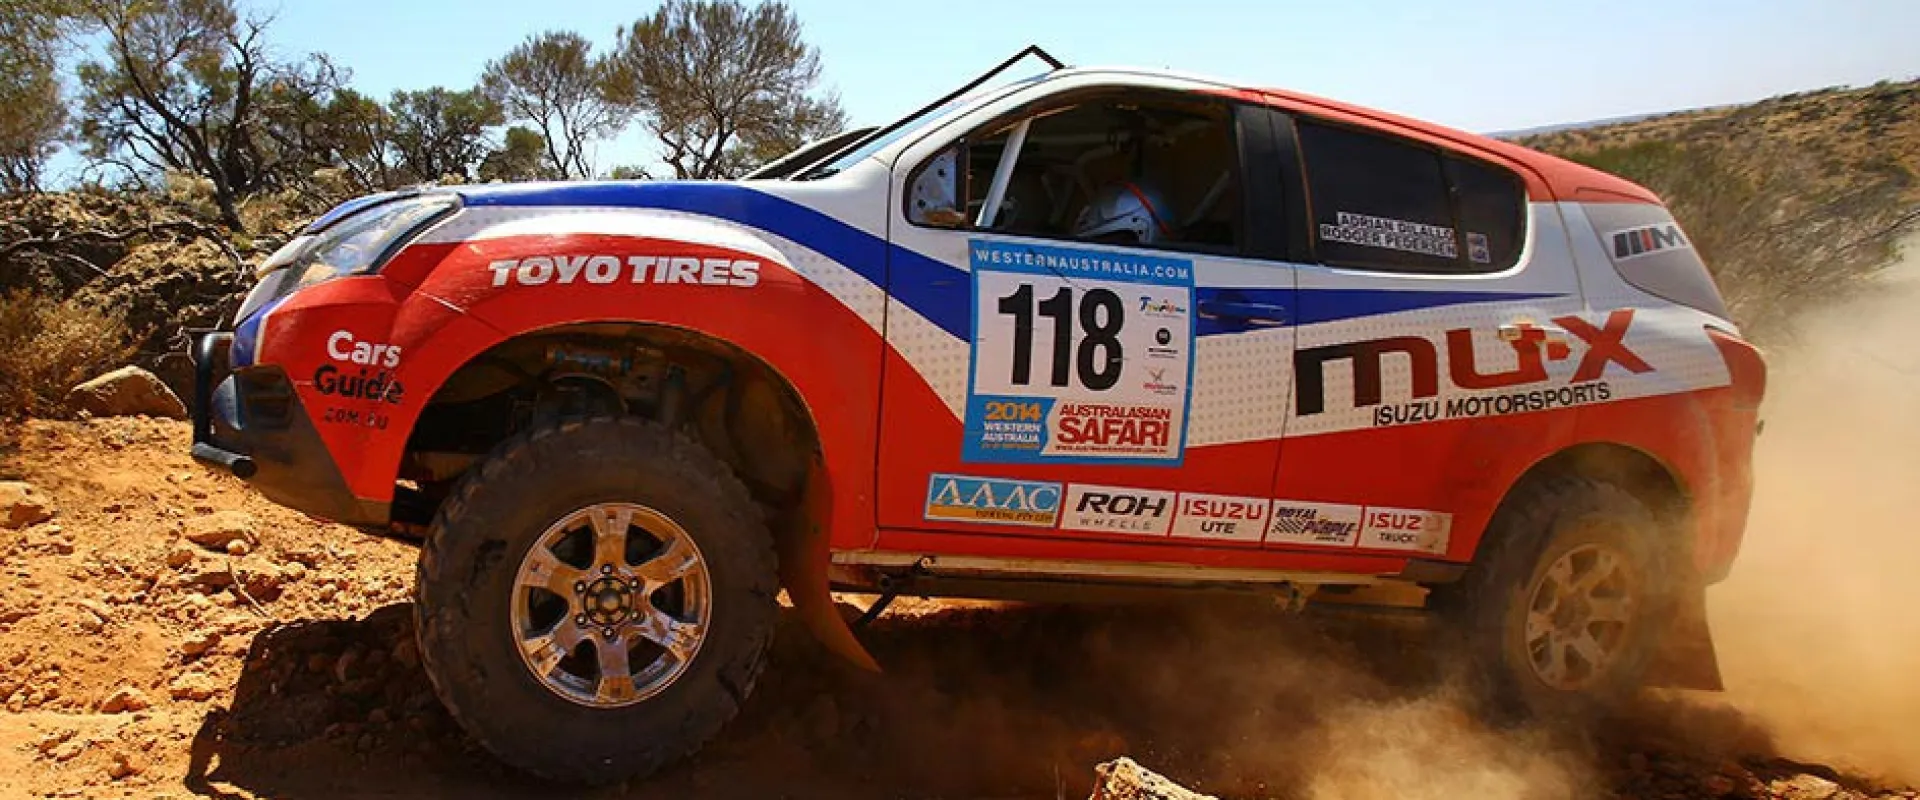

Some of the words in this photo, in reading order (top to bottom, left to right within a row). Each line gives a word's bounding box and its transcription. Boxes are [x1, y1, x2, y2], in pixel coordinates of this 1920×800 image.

[489, 256, 620, 287] TOYO
[628, 256, 760, 287] TIRES
[975, 250, 1189, 280] WESTERNAUSTRALIA.COM
[327, 330, 402, 368] Cars
[998, 283, 1124, 391] 118
[314, 364, 405, 404] Guide
[984, 402, 1042, 421] 2014
[1059, 404, 1172, 420] AUSTRALASIAN
[1373, 405, 1438, 426] ISUZU
[1445, 382, 1611, 418] MOTORSPORTS
[1057, 417, 1170, 446] SAFARI
[932, 479, 1058, 512] AAAC
[1076, 492, 1168, 518] ROH
[1182, 498, 1263, 520] ISUZU
[1079, 517, 1151, 531] WHEELS
[1201, 520, 1236, 534] UTE
